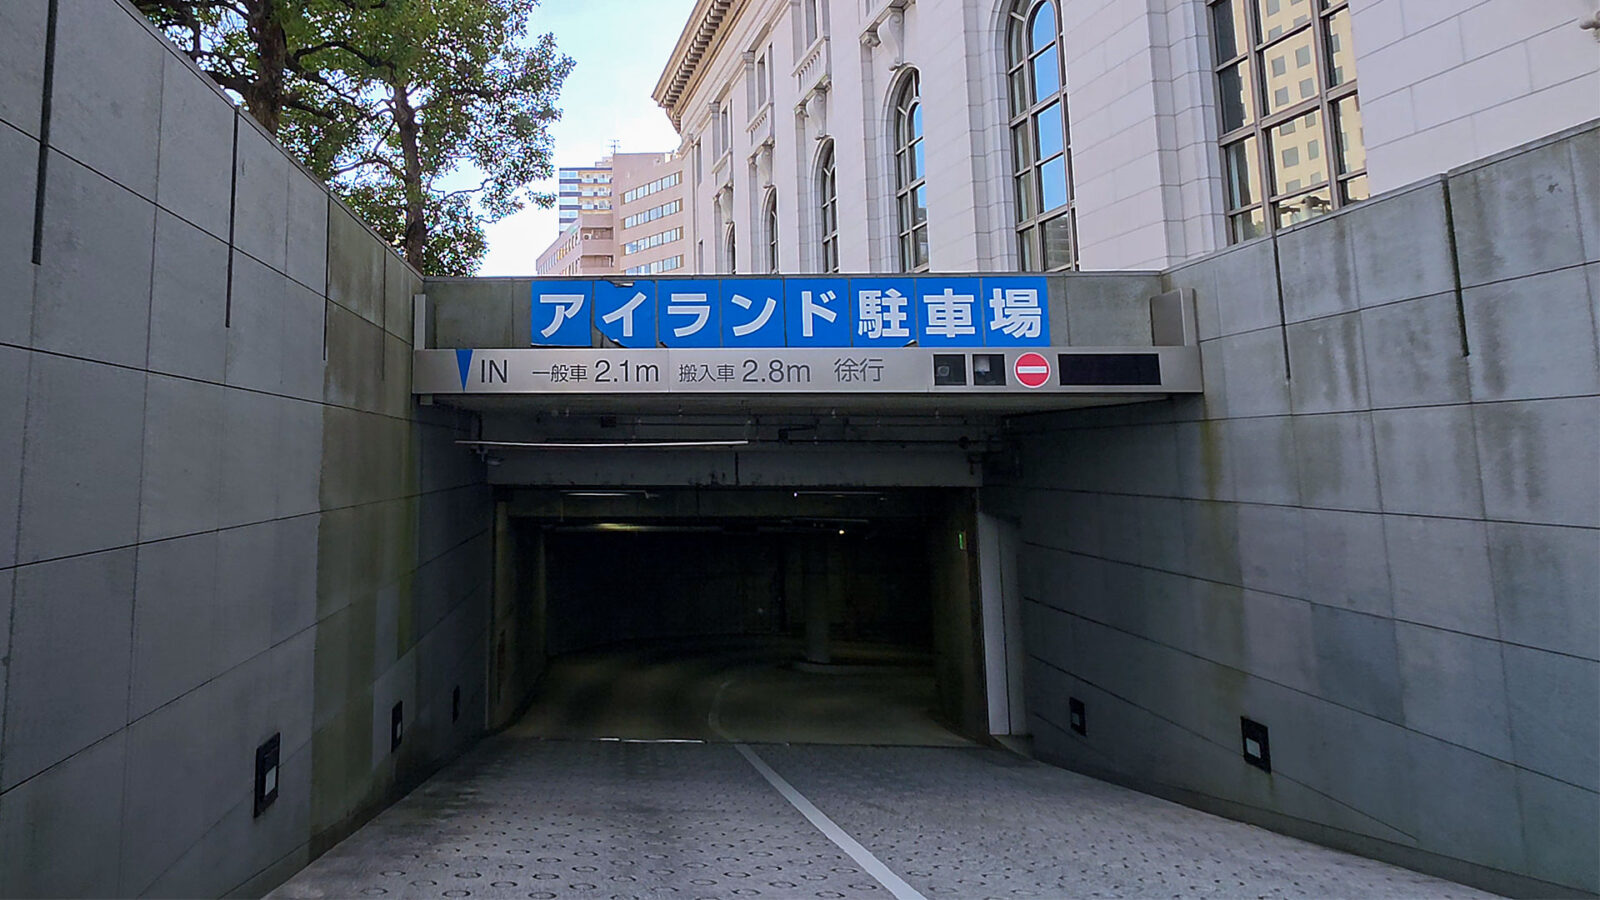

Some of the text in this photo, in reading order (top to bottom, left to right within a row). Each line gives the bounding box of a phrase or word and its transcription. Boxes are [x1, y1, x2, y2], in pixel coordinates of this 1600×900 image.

[538, 288, 1043, 339] アイランド駐車場
[480, 357, 884, 383] IN 一般車 2.1m 搬入車 2.8m 徐行
